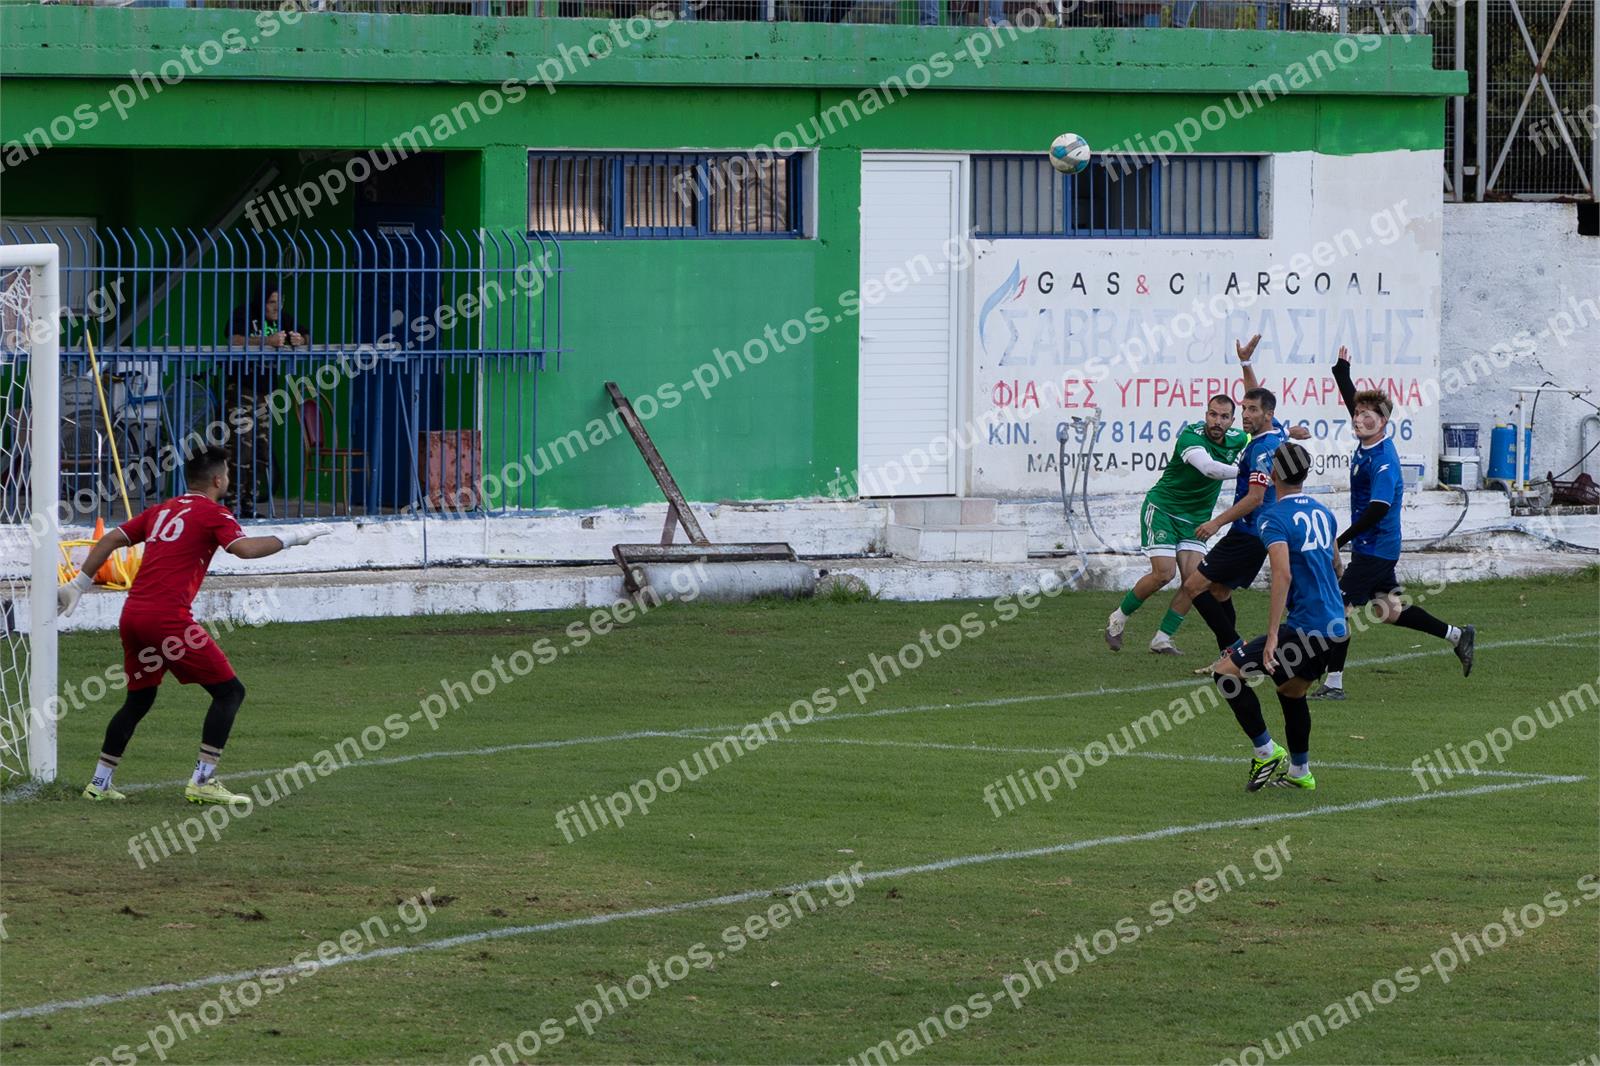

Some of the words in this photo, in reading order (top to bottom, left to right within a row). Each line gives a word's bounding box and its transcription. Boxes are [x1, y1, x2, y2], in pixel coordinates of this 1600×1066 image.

[1037, 271, 1121, 295] GAS
[1136, 274, 1149, 295] &
[992, 378, 1098, 409] ΦΙΑΕΣ
[1056, 420, 1205, 444] 6978146
[146, 507, 192, 543] 16
[1293, 509, 1331, 552] 20
